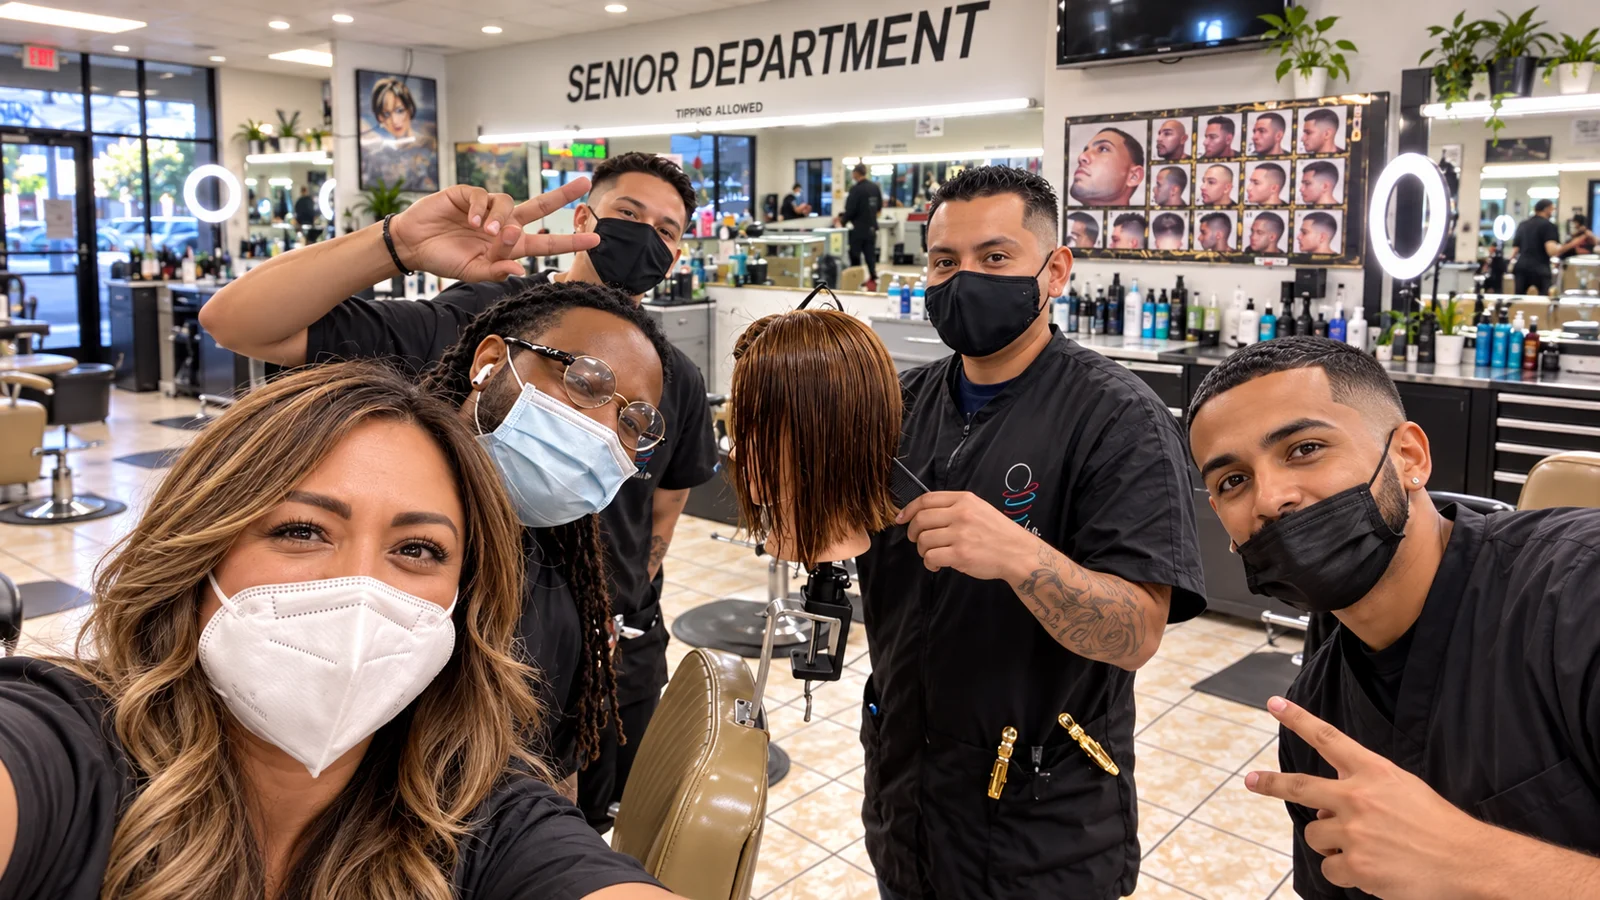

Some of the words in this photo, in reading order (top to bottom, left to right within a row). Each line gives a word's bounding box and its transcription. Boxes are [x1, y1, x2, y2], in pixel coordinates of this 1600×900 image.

[567, 51, 679, 103] SENIOR
[690, 1, 990, 89] DEPARTMENT
[676, 106, 712, 119] TIPPING
[715, 102, 763, 115] ALLOWED
